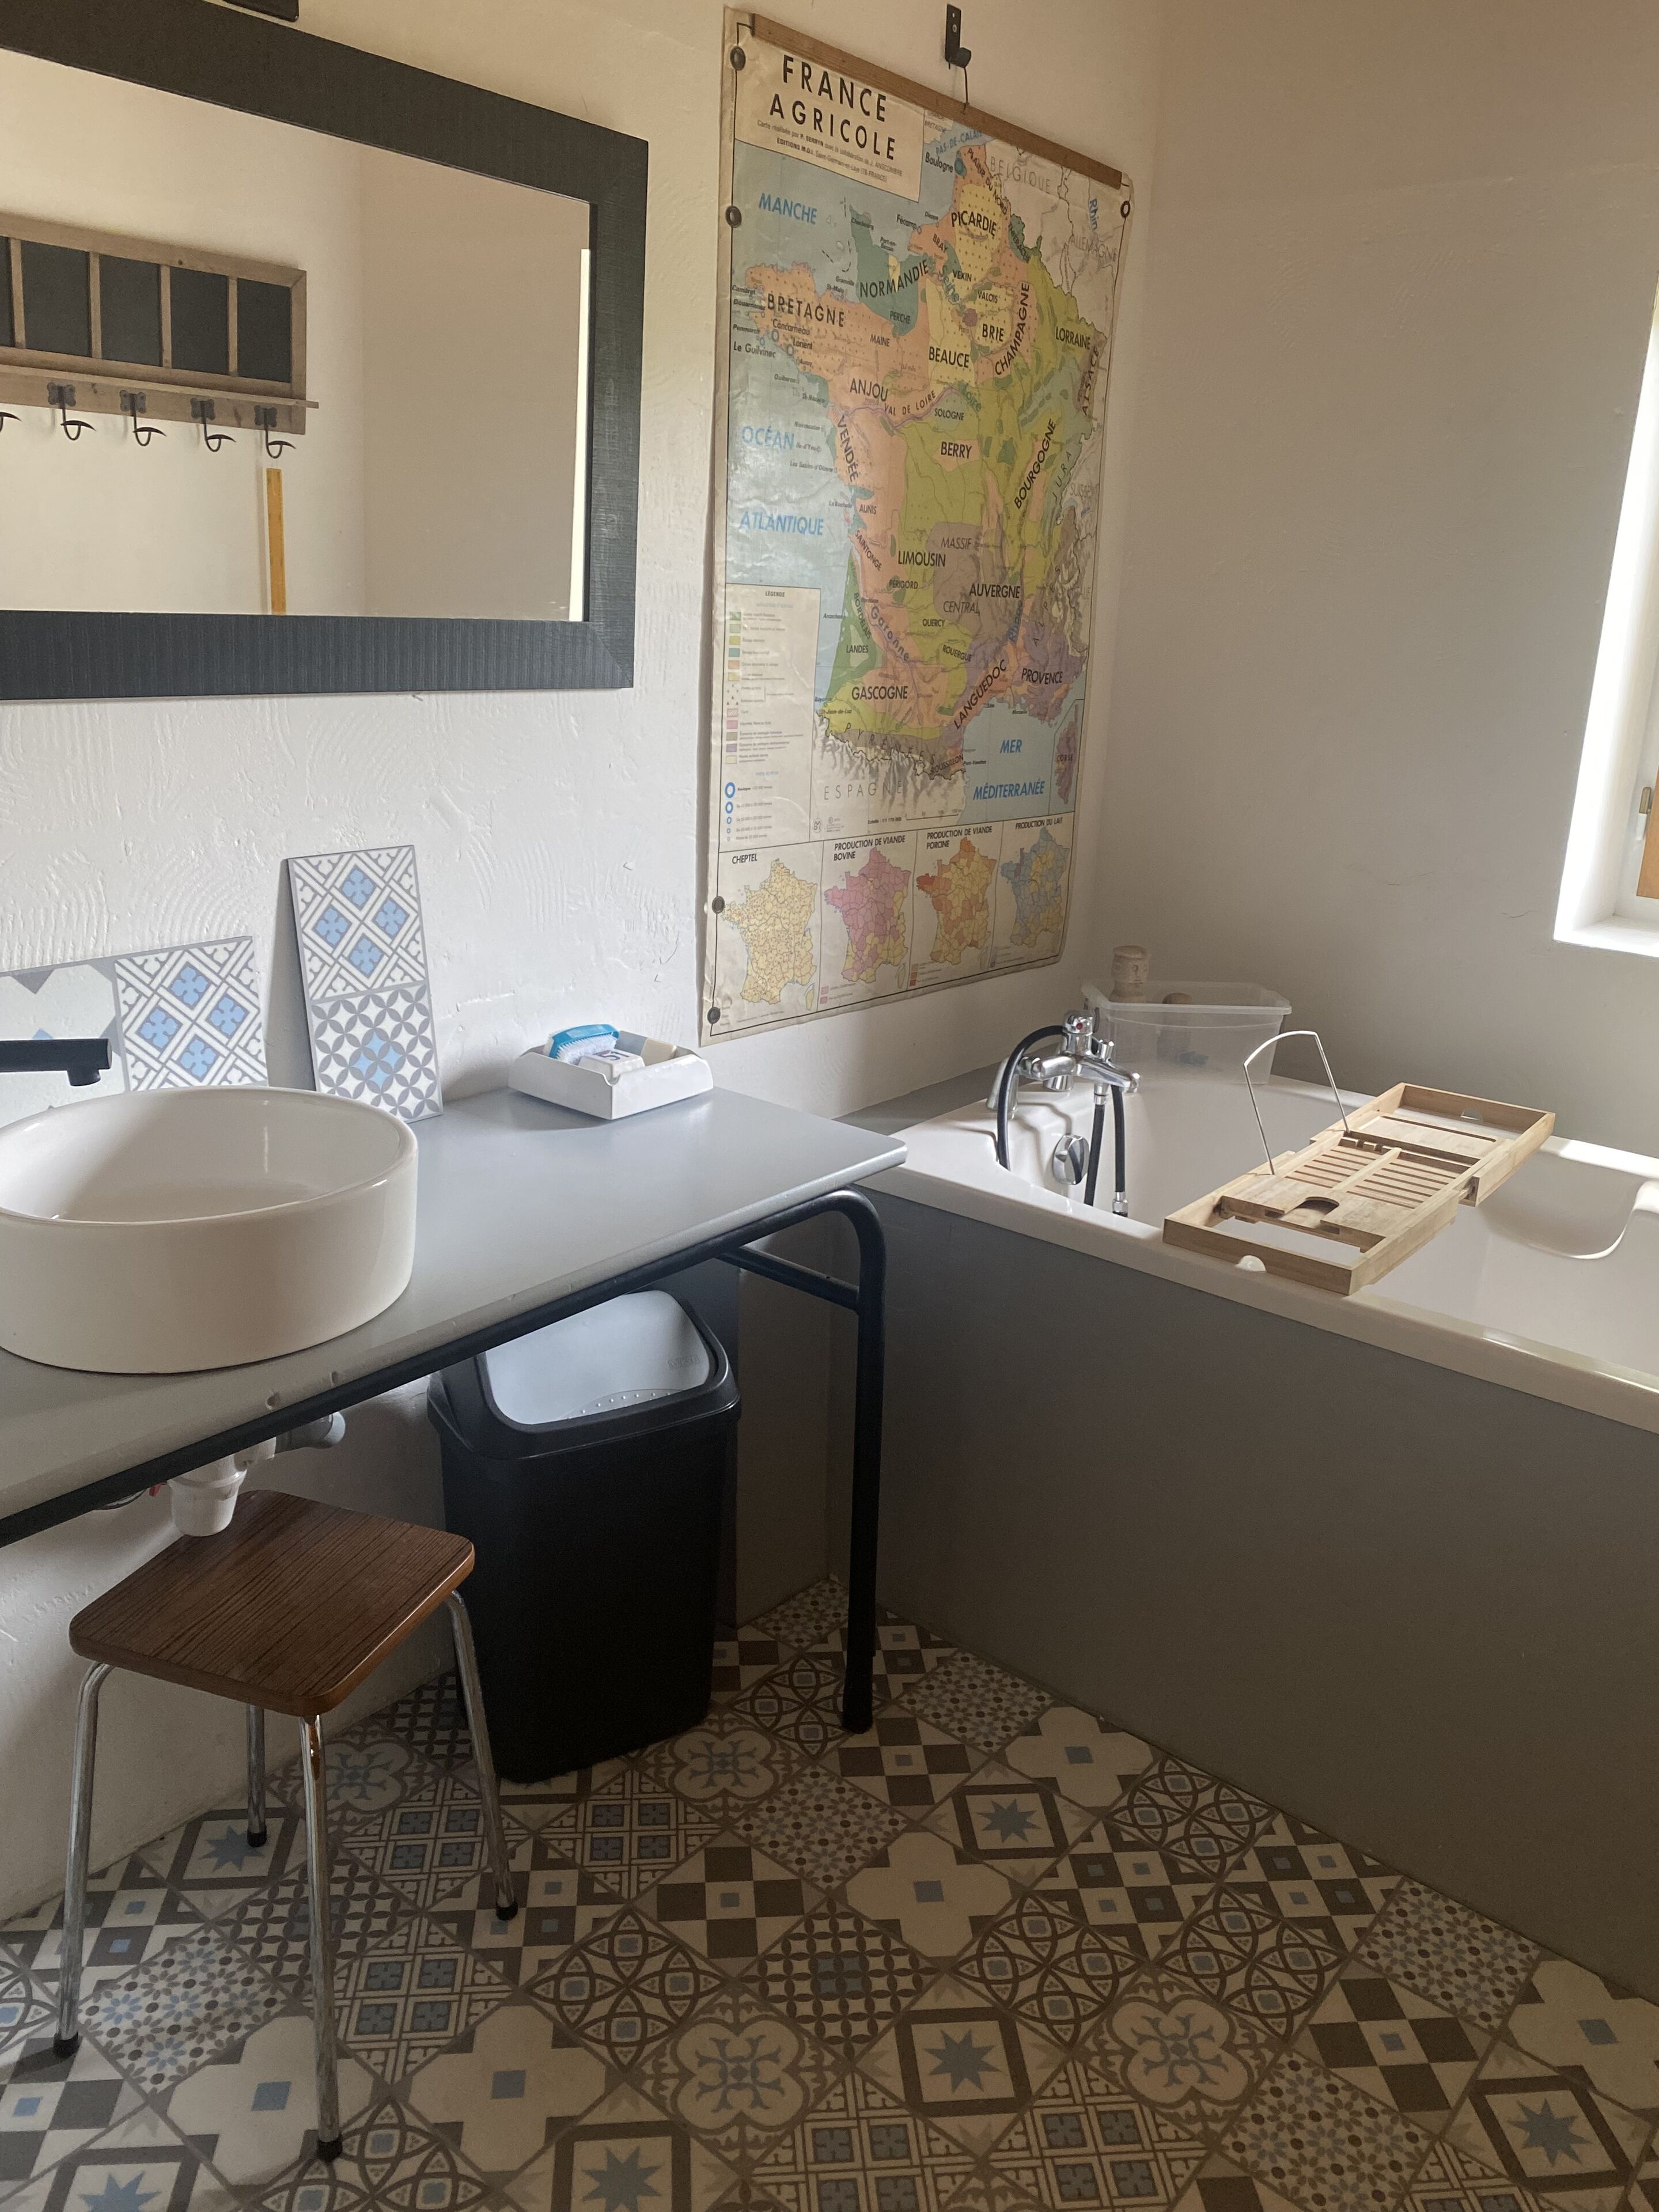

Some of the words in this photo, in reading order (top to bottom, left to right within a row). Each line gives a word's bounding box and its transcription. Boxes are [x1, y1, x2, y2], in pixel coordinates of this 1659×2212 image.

[783, 54, 887, 123] FRANCE
[769, 93, 895, 161] AGRICOLE
[925, 151, 954, 173] Boulogne
[967, 147, 986, 179] PLAINE
[993, 189, 1008, 215] NORD
[990, 156, 1051, 194] BELGIQUE
[759, 192, 817, 225] MANCHE
[896, 214, 918, 230] Fécamp
[951, 210, 997, 237] PICARDIE
[933, 233, 948, 253] BRAY
[1070, 234, 1118, 262] ALLEMAGNE
[860, 259, 929, 298] NORMANDIE
[952, 268, 972, 282] VEXIN
[978, 290, 998, 304] VALOIS
[767, 293, 844, 328] BRETAGNE
[889, 310, 911, 325] PERCHE
[772, 318, 810, 336] Concarneau
[982, 323, 1005, 342] BRIE
[994, 282, 1029, 376] CHAMPAGNE
[870, 333, 891, 347] MAINE
[1055, 326, 1091, 351] LORRAINE
[733, 340, 742, 352] Le
[745, 343, 777, 358] Guilvinec
[929, 346, 970, 369] BEAUCE
[849, 377, 888, 402] ANJOU
[1082, 348, 1100, 416] ALSACE
[884, 403, 896, 416] VAL
[902, 404, 911, 415] DE
[915, 389, 937, 411] LOIRE
[934, 407, 965, 421] SOLOGNE
[741, 425, 795, 452] OCÉAN
[837, 414, 859, 482] VENDÉE
[940, 441, 972, 459] BERRY
[1013, 418, 1056, 510] BOURGOGNE
[859, 504, 877, 515] AUNIS
[738, 510, 824, 536] ATLANTIQUE
[855, 529, 882, 571] SAINTONGE
[940, 536, 974, 551] MASSIF
[897, 550, 946, 567] LIMOUSIN
[969, 584, 1021, 599] AUVERGNE
[943, 600, 979, 614] CENTRAL
[922, 618, 945, 627] QUERCY
[870, 606, 910, 662] Garonne
[846, 645, 869, 654] LANDES
[942, 644, 972, 662] ROUERGUE
[1021, 667, 1063, 685] PROVENCE
[851, 685, 908, 700] GASCOGNE
[954, 659, 1007, 730] LANGUEDOC
[999, 738, 1023, 755] MER
[930, 753, 964, 775] ROUSSILLON
[823, 779, 903, 800] ESPAGNE
[972, 779, 1046, 801] MÉDITERRANÉE
[926, 829, 963, 840] PRODUCTION
[964, 828, 972, 836] DE
[973, 825, 993, 835] VIANDE
[1015, 819, 1046, 830] PRODUCTION
[1054, 816, 1063, 825] LAIT
[834, 838, 873, 851] PRODUCTION
[874, 838, 882, 846] DE
[883, 835, 906, 844] VIANDE
[926, 840, 950, 850] PORCINE
[731, 853, 758, 865] CHEPTEL
[834, 851, 856, 862] BOVINE
